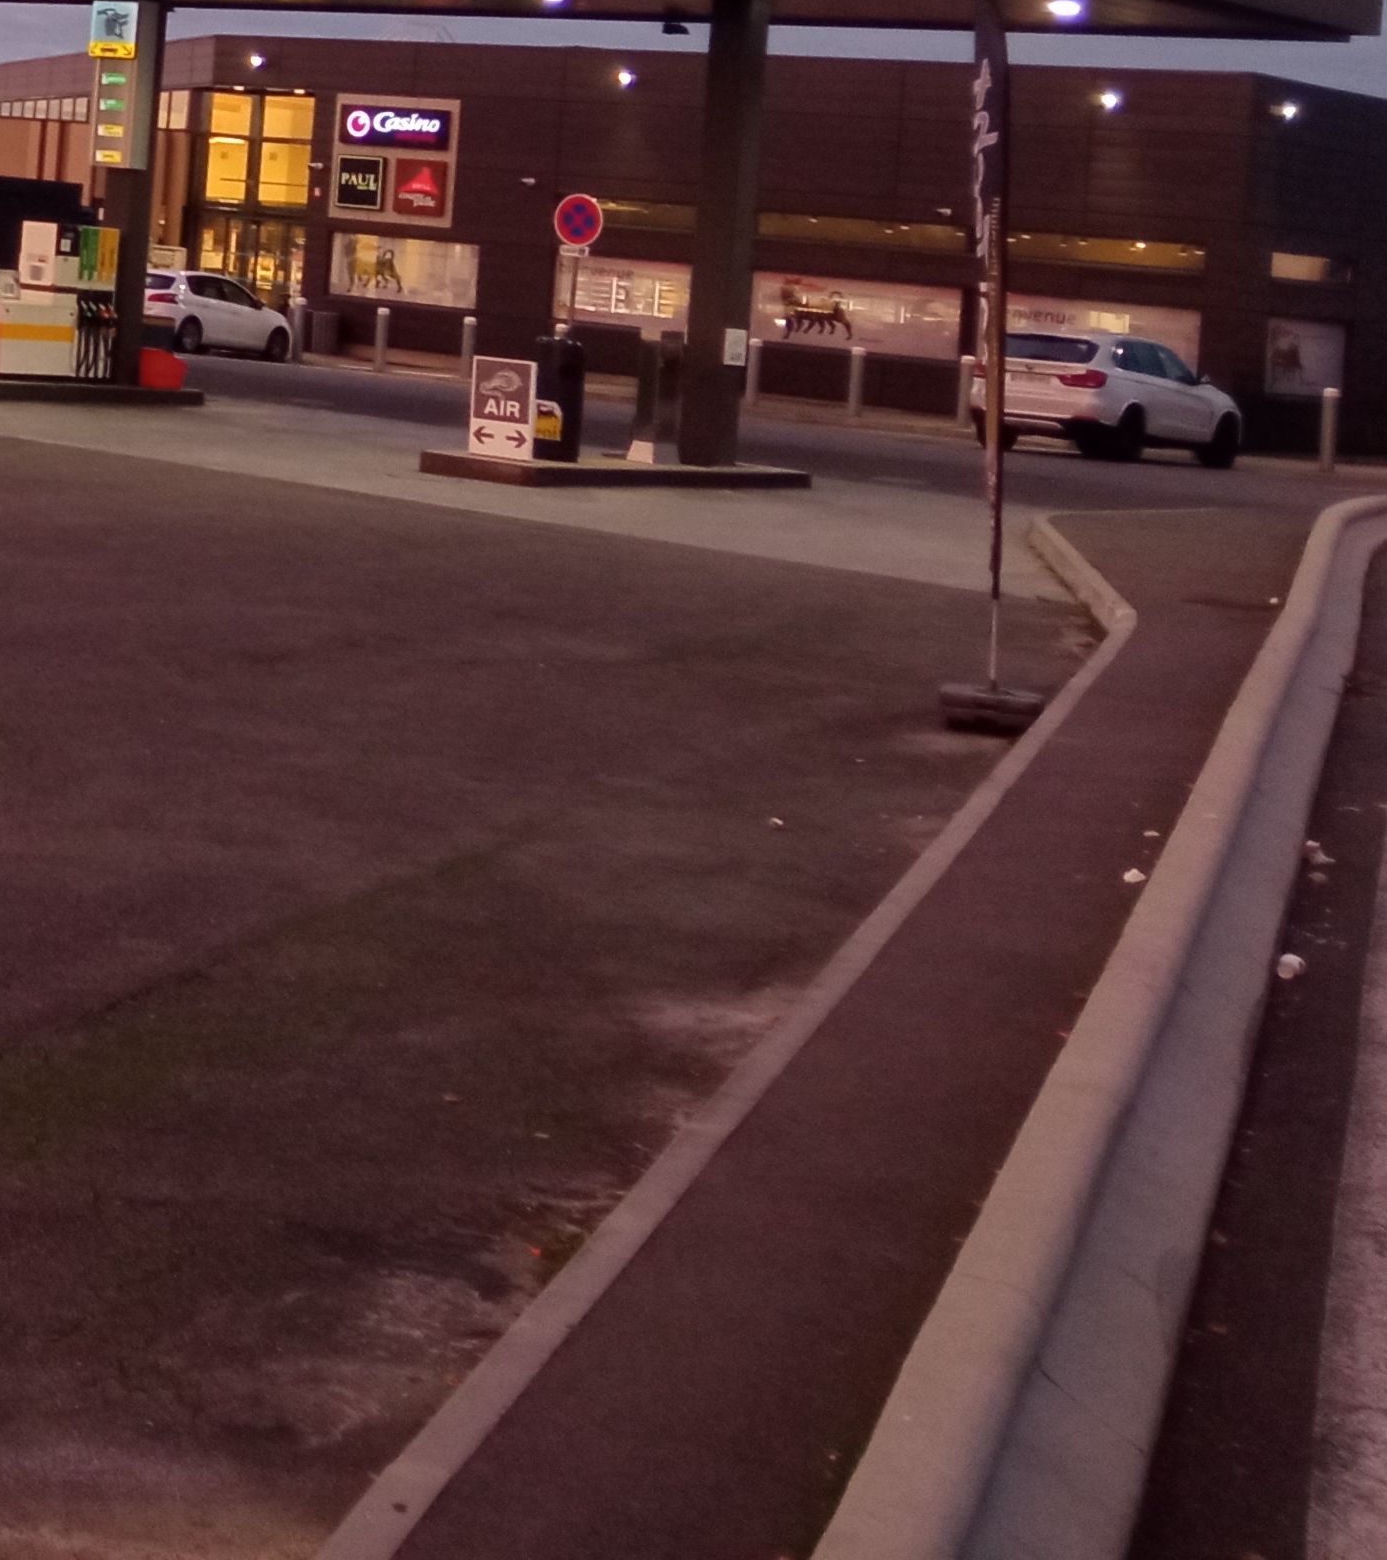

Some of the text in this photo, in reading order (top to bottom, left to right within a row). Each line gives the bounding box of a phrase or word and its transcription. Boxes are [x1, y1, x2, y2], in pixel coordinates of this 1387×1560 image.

[373, 111, 441, 133] Casino
[341, 173, 377, 191] PAUL
[483, 398, 521, 418] AIR
